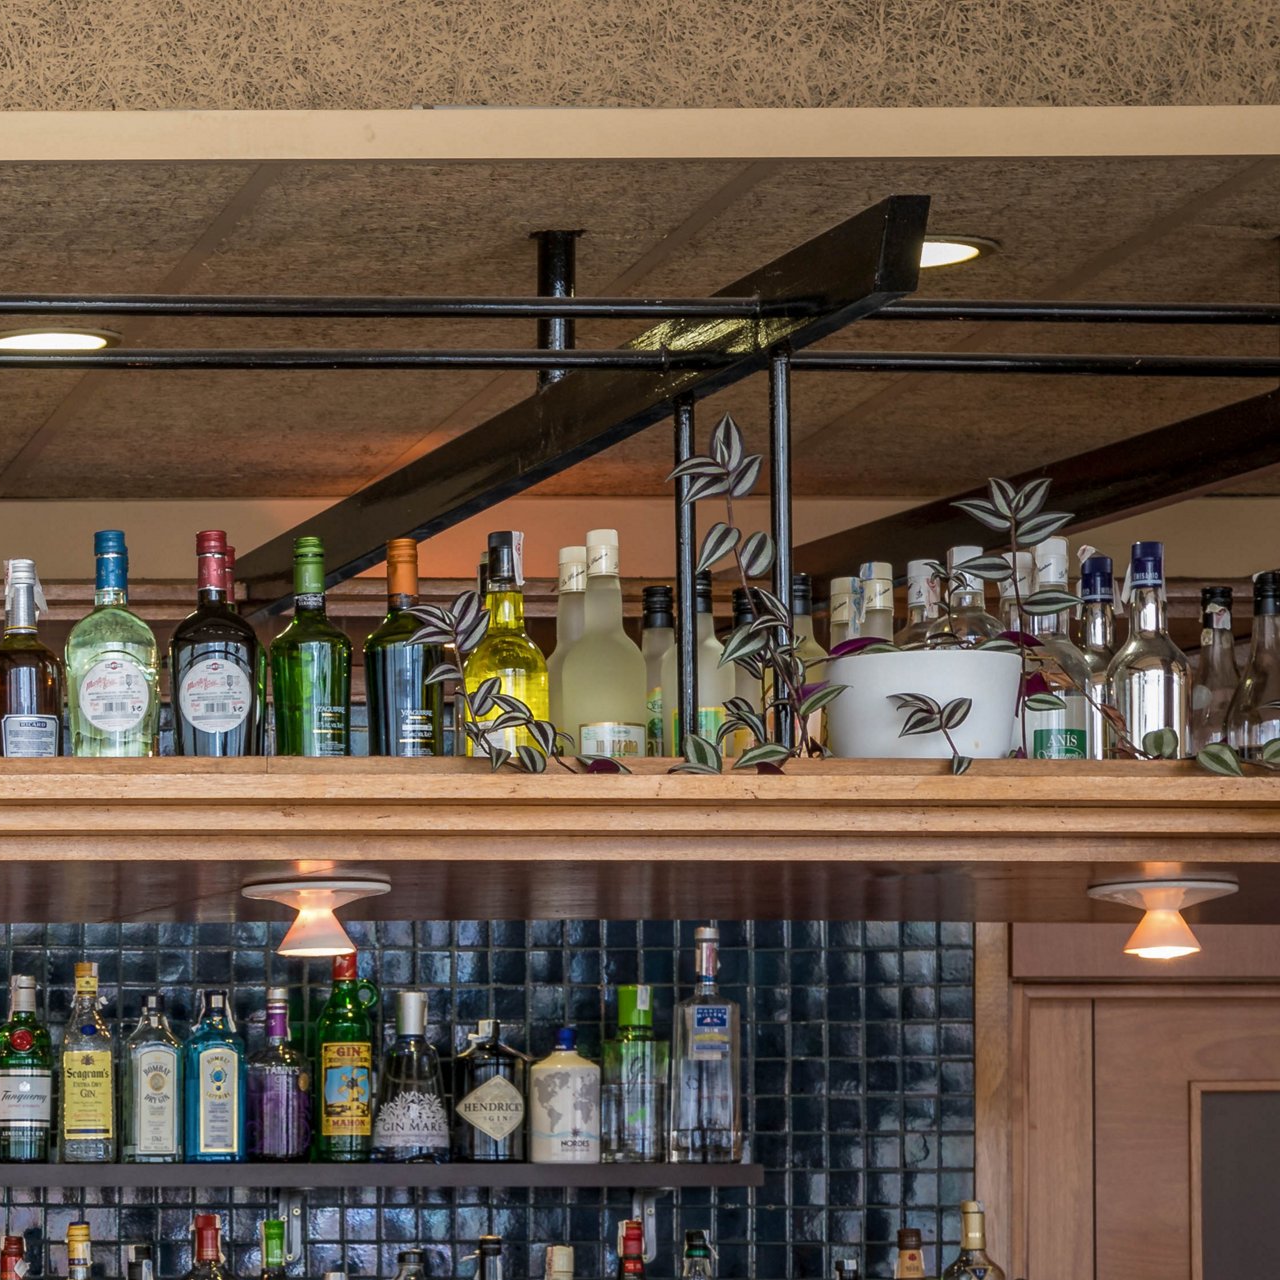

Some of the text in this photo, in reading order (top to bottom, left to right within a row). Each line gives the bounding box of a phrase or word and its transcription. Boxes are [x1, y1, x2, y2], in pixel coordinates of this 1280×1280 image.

[1047, 732, 1077, 747] ANÍS
[336, 1046, 361, 1057] GIN
[66, 1068, 109, 1080] Seagram's
[1, 1090, 47, 1103] Tanqueray
[80, 1089, 96, 1098] GIN
[383, 1122, 405, 1131] GIN
